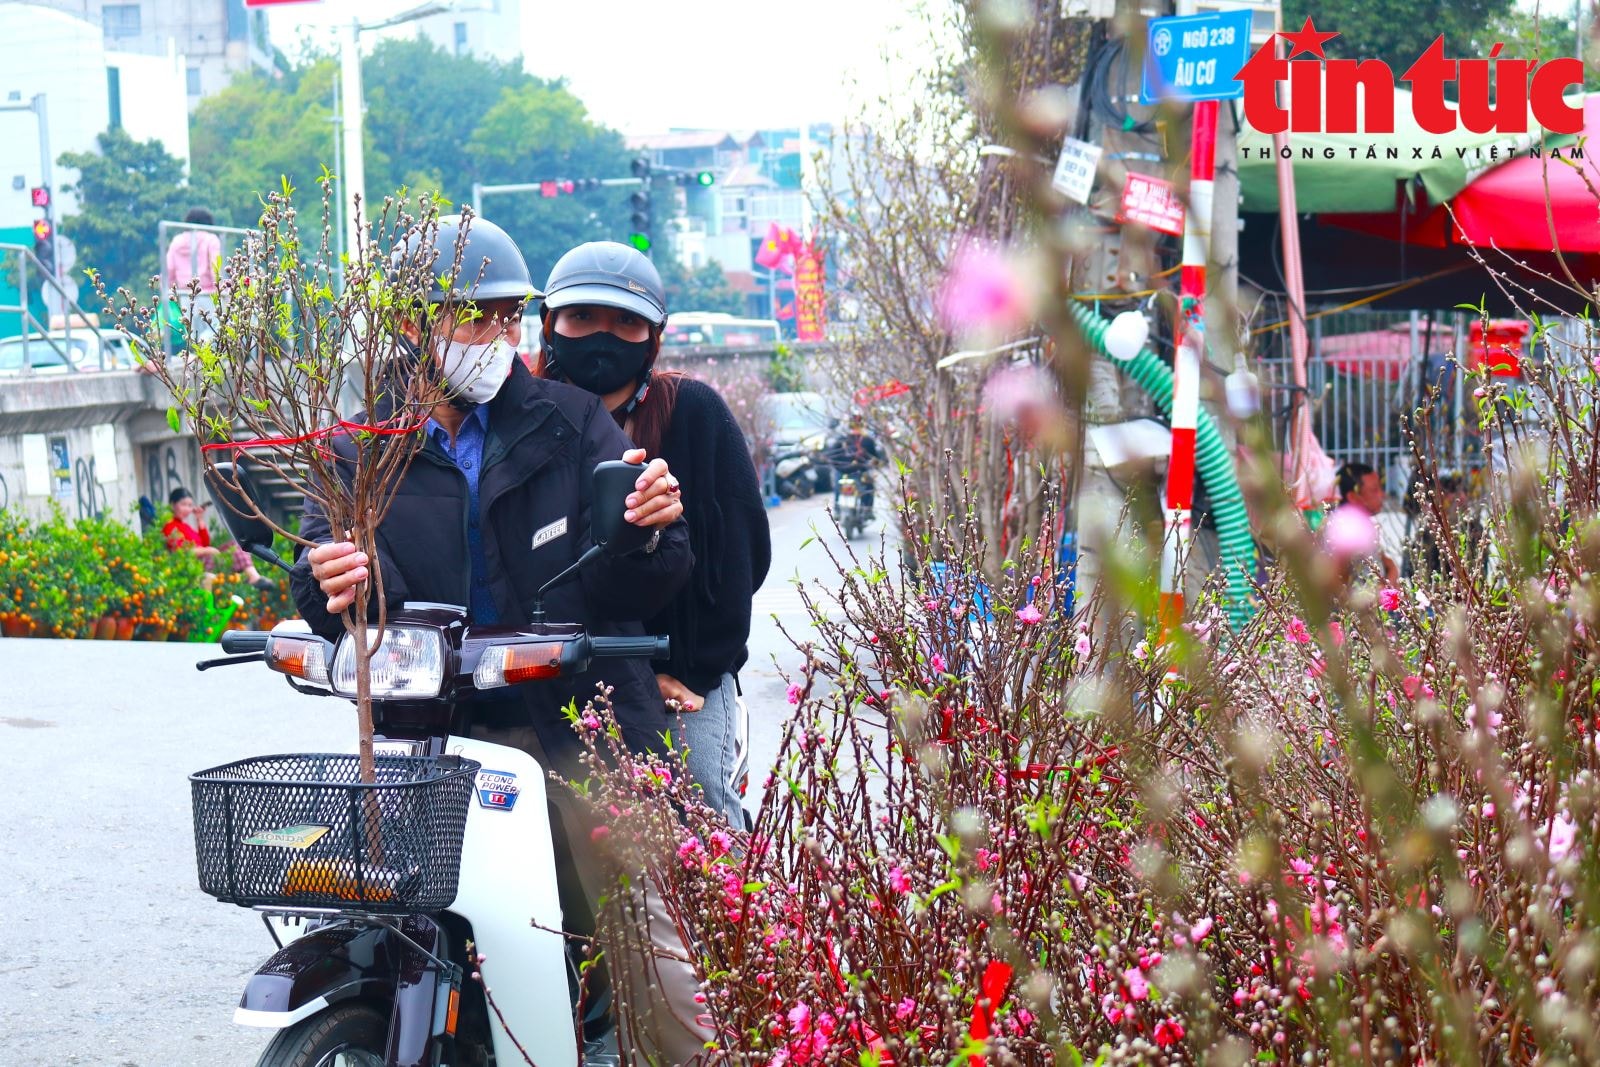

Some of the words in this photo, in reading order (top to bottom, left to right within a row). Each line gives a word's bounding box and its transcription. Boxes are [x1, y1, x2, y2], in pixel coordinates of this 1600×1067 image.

[1209, 26, 1235, 47] 238
[1174, 57, 1195, 86] ÂU
[373, 748, 407, 758] ONDA
[480, 772, 514, 785] ECONO
[481, 781, 518, 793] POWER
[254, 831, 305, 843] HONDA
